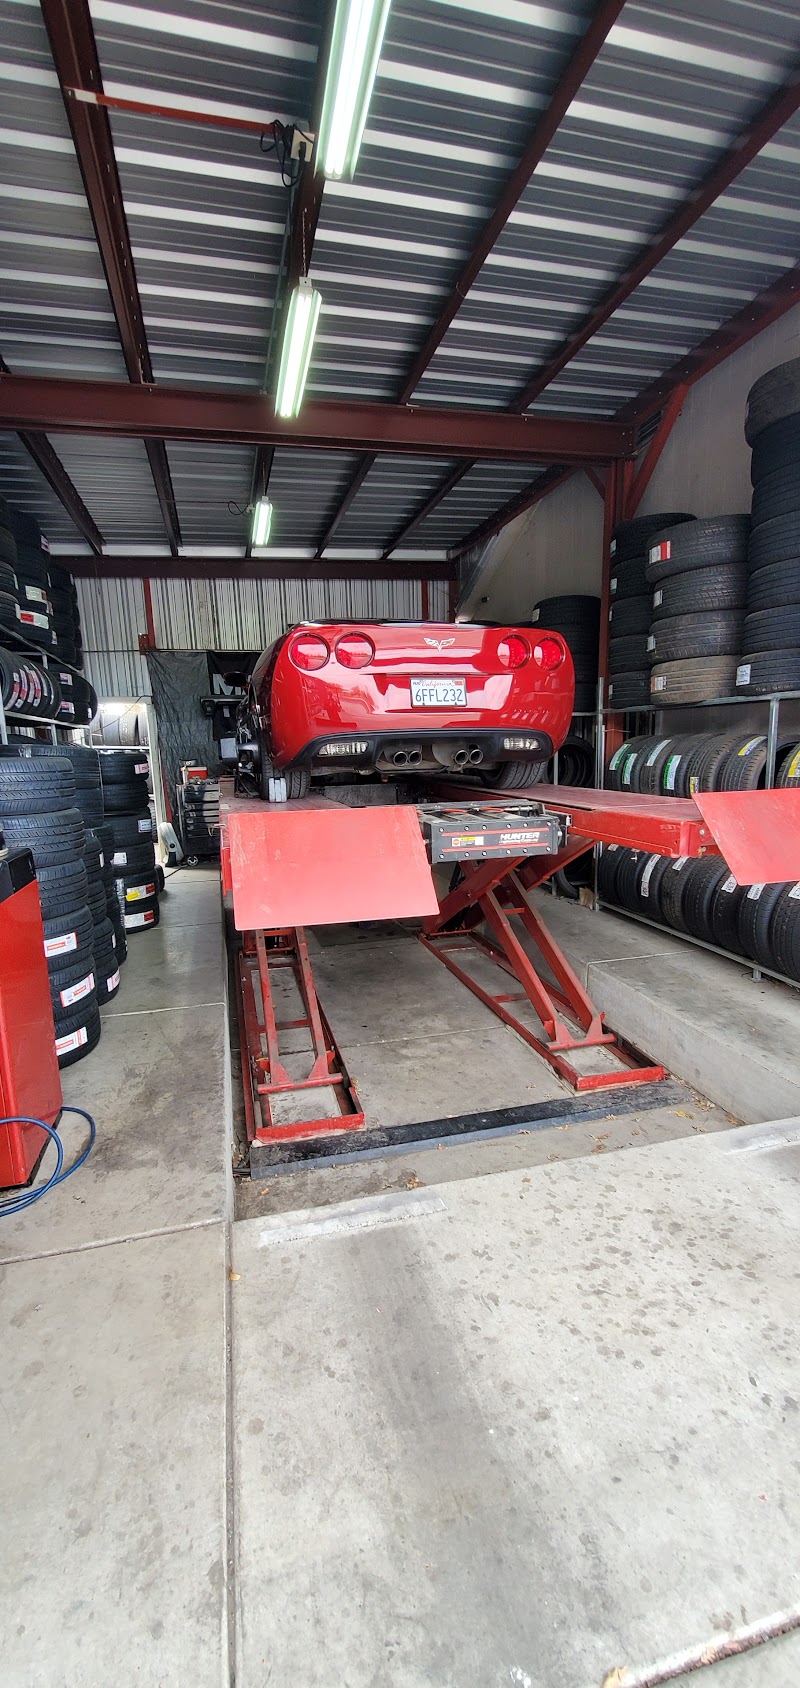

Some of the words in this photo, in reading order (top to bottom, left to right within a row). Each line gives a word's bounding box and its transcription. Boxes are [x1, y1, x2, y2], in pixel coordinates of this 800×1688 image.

[421, 680, 453, 688] California
[415, 688, 464, 702] 6FFL232
[500, 832, 540, 841] HUNTER
